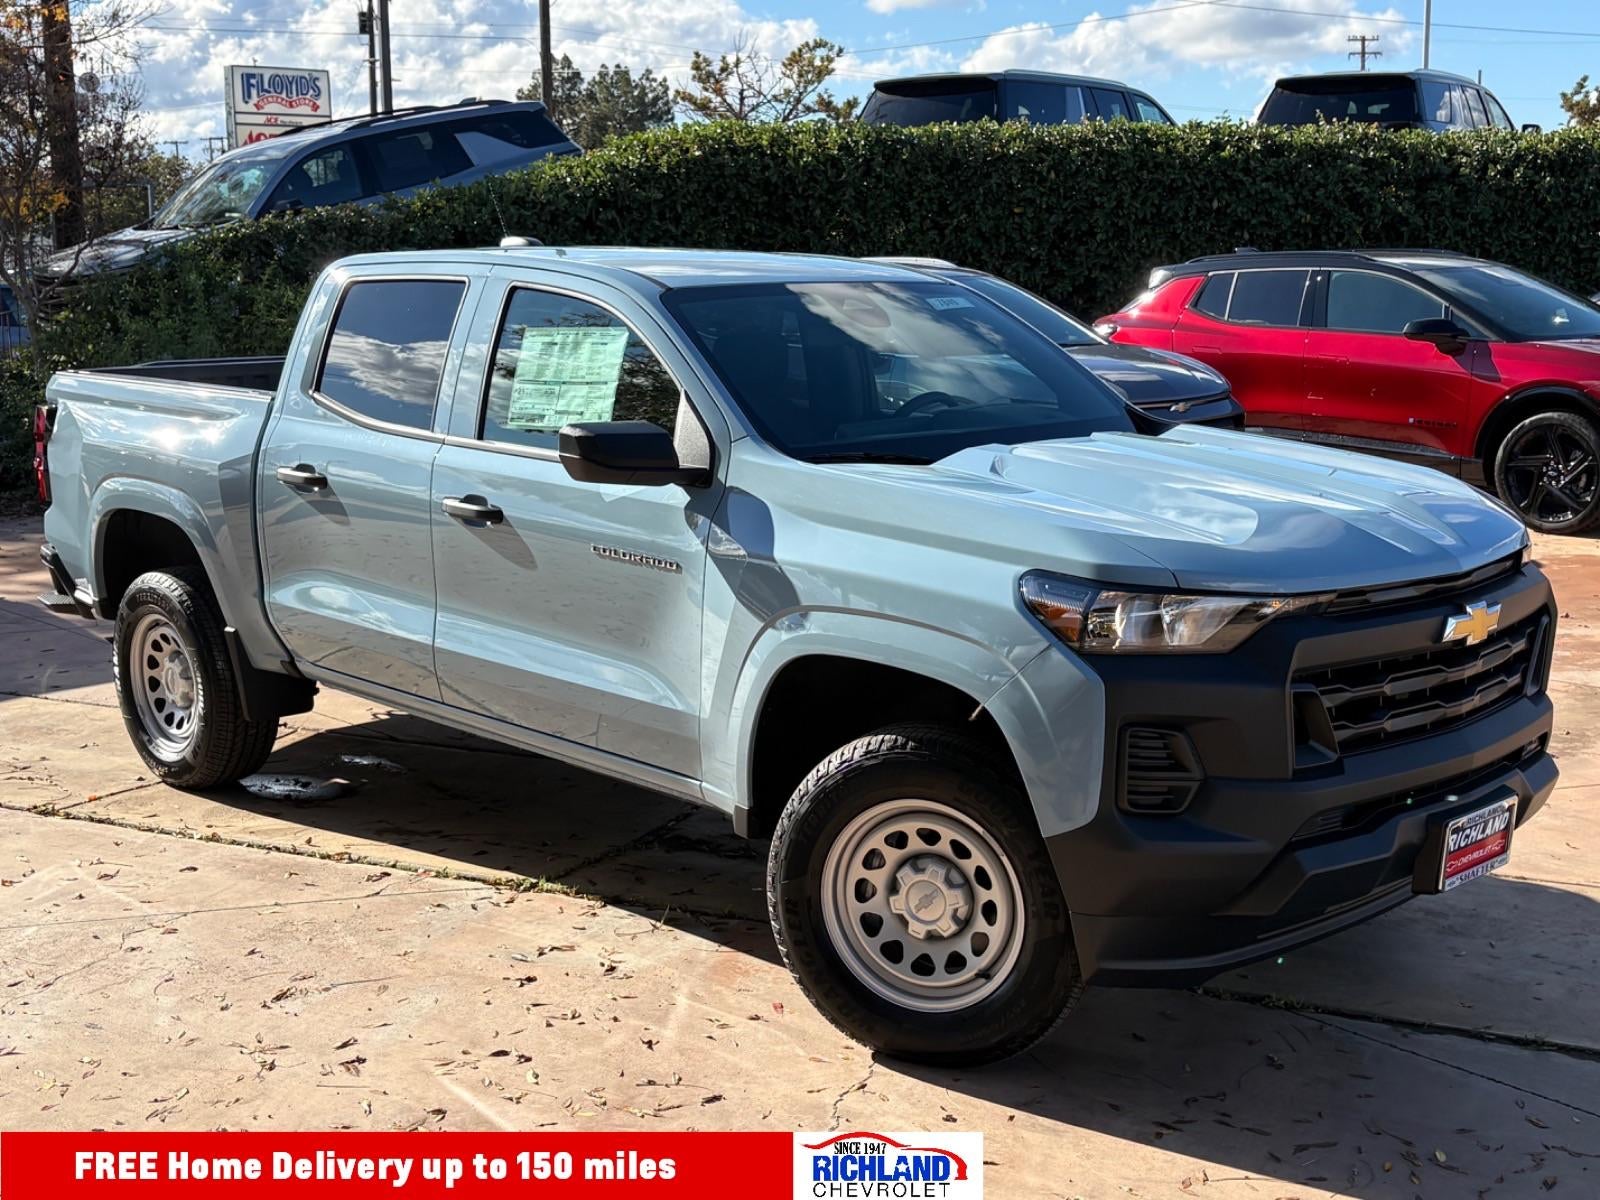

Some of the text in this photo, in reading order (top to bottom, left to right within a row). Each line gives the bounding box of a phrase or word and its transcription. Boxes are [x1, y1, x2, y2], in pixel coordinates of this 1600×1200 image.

[241, 73, 321, 103] FLOYD'S
[590, 544, 681, 569] COLORADO
[1448, 812, 1510, 852] RICHLAND
